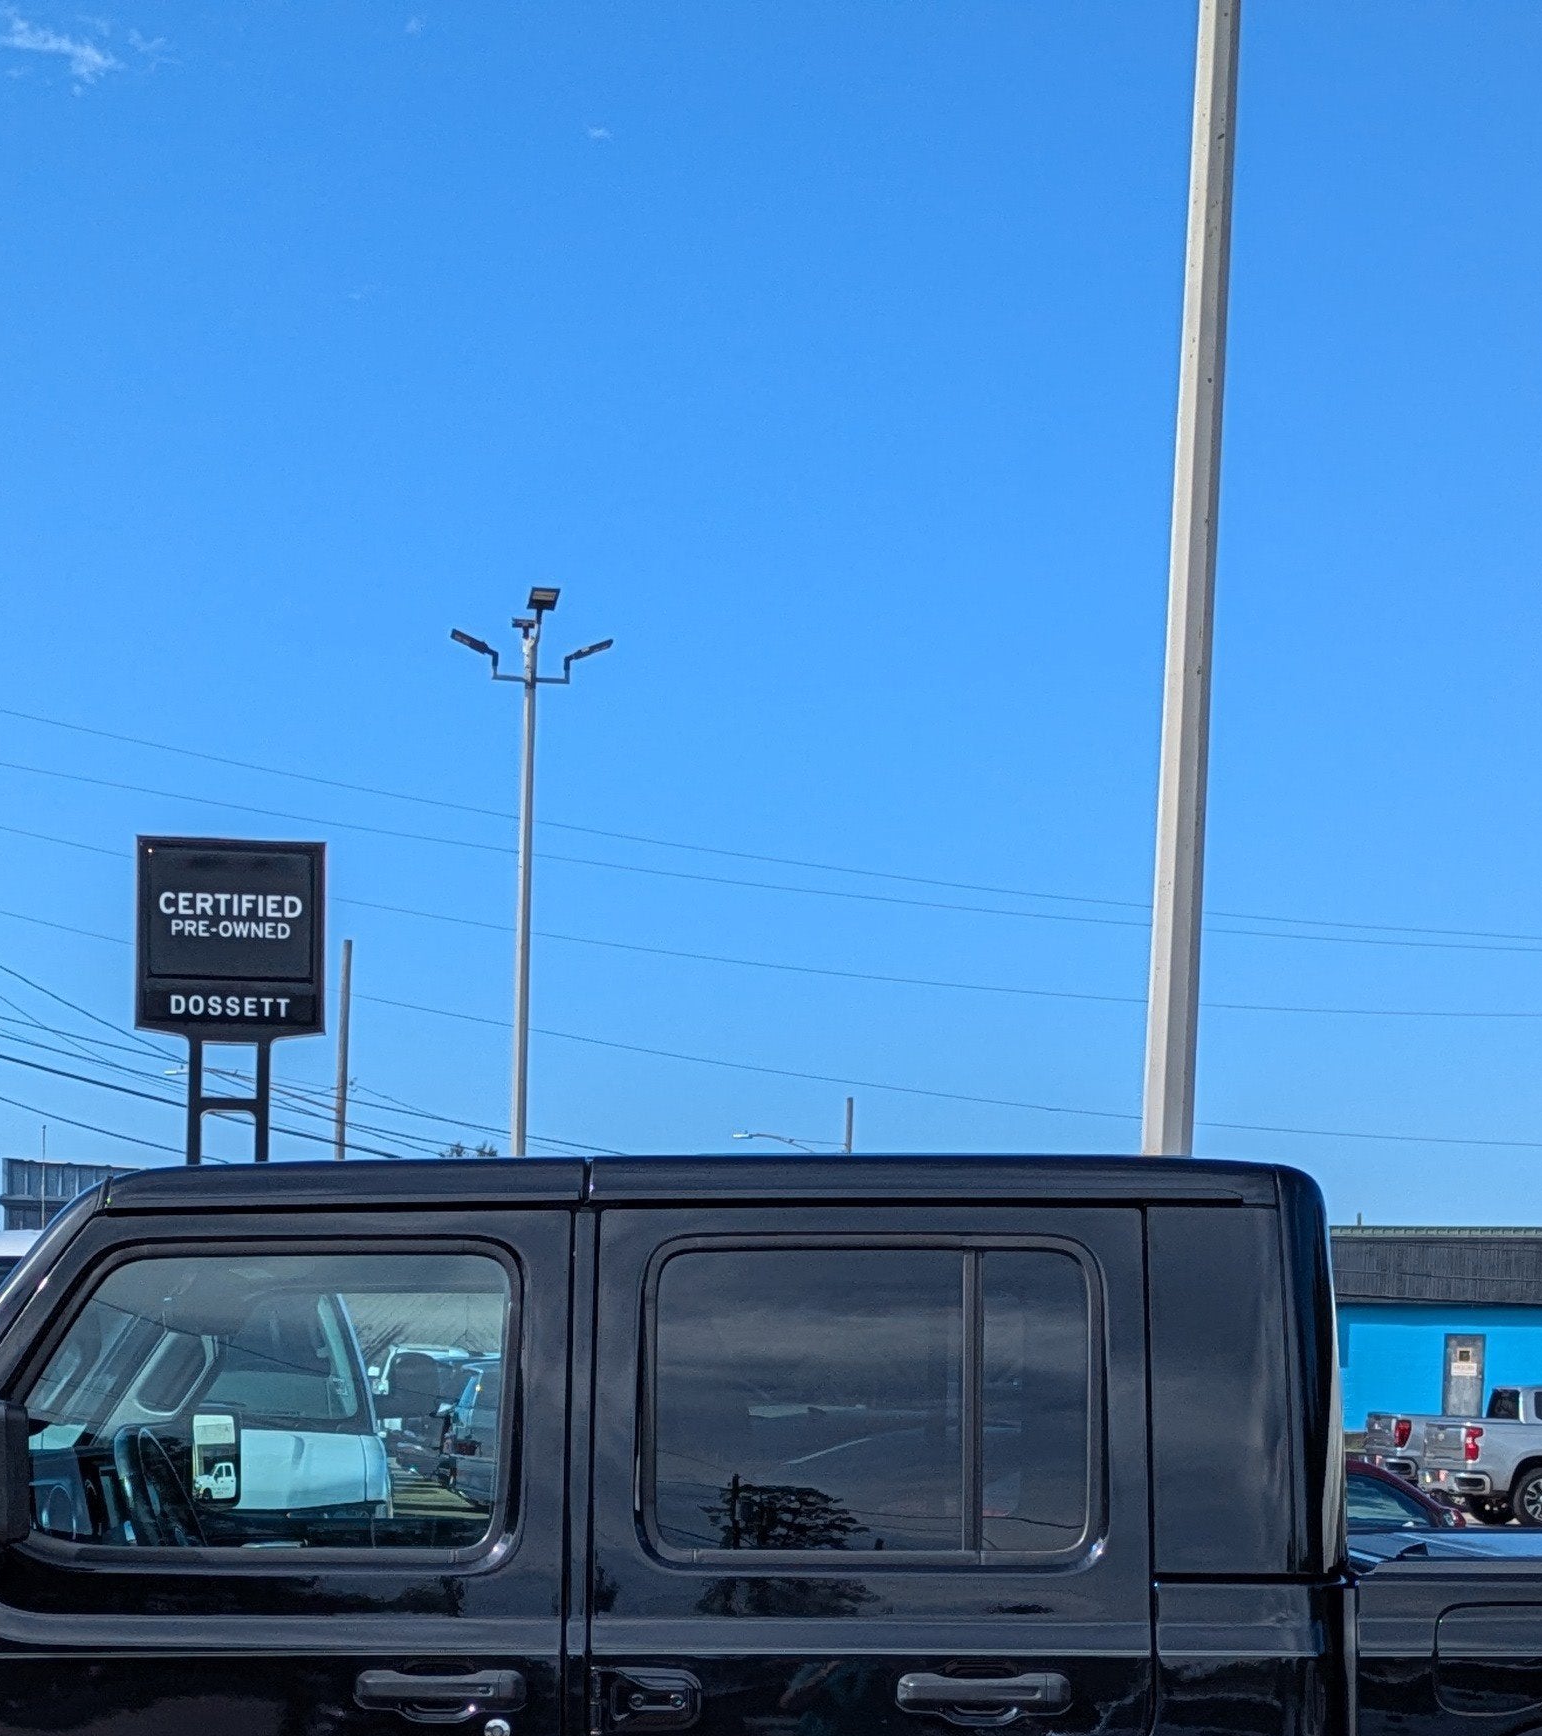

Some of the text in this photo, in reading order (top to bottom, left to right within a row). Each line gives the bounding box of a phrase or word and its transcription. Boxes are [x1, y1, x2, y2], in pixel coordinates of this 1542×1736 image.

[158, 890, 303, 919] CERTIFIED
[170, 919, 292, 940] PRE-OWNED
[169, 993, 291, 1019] DOSSETT
